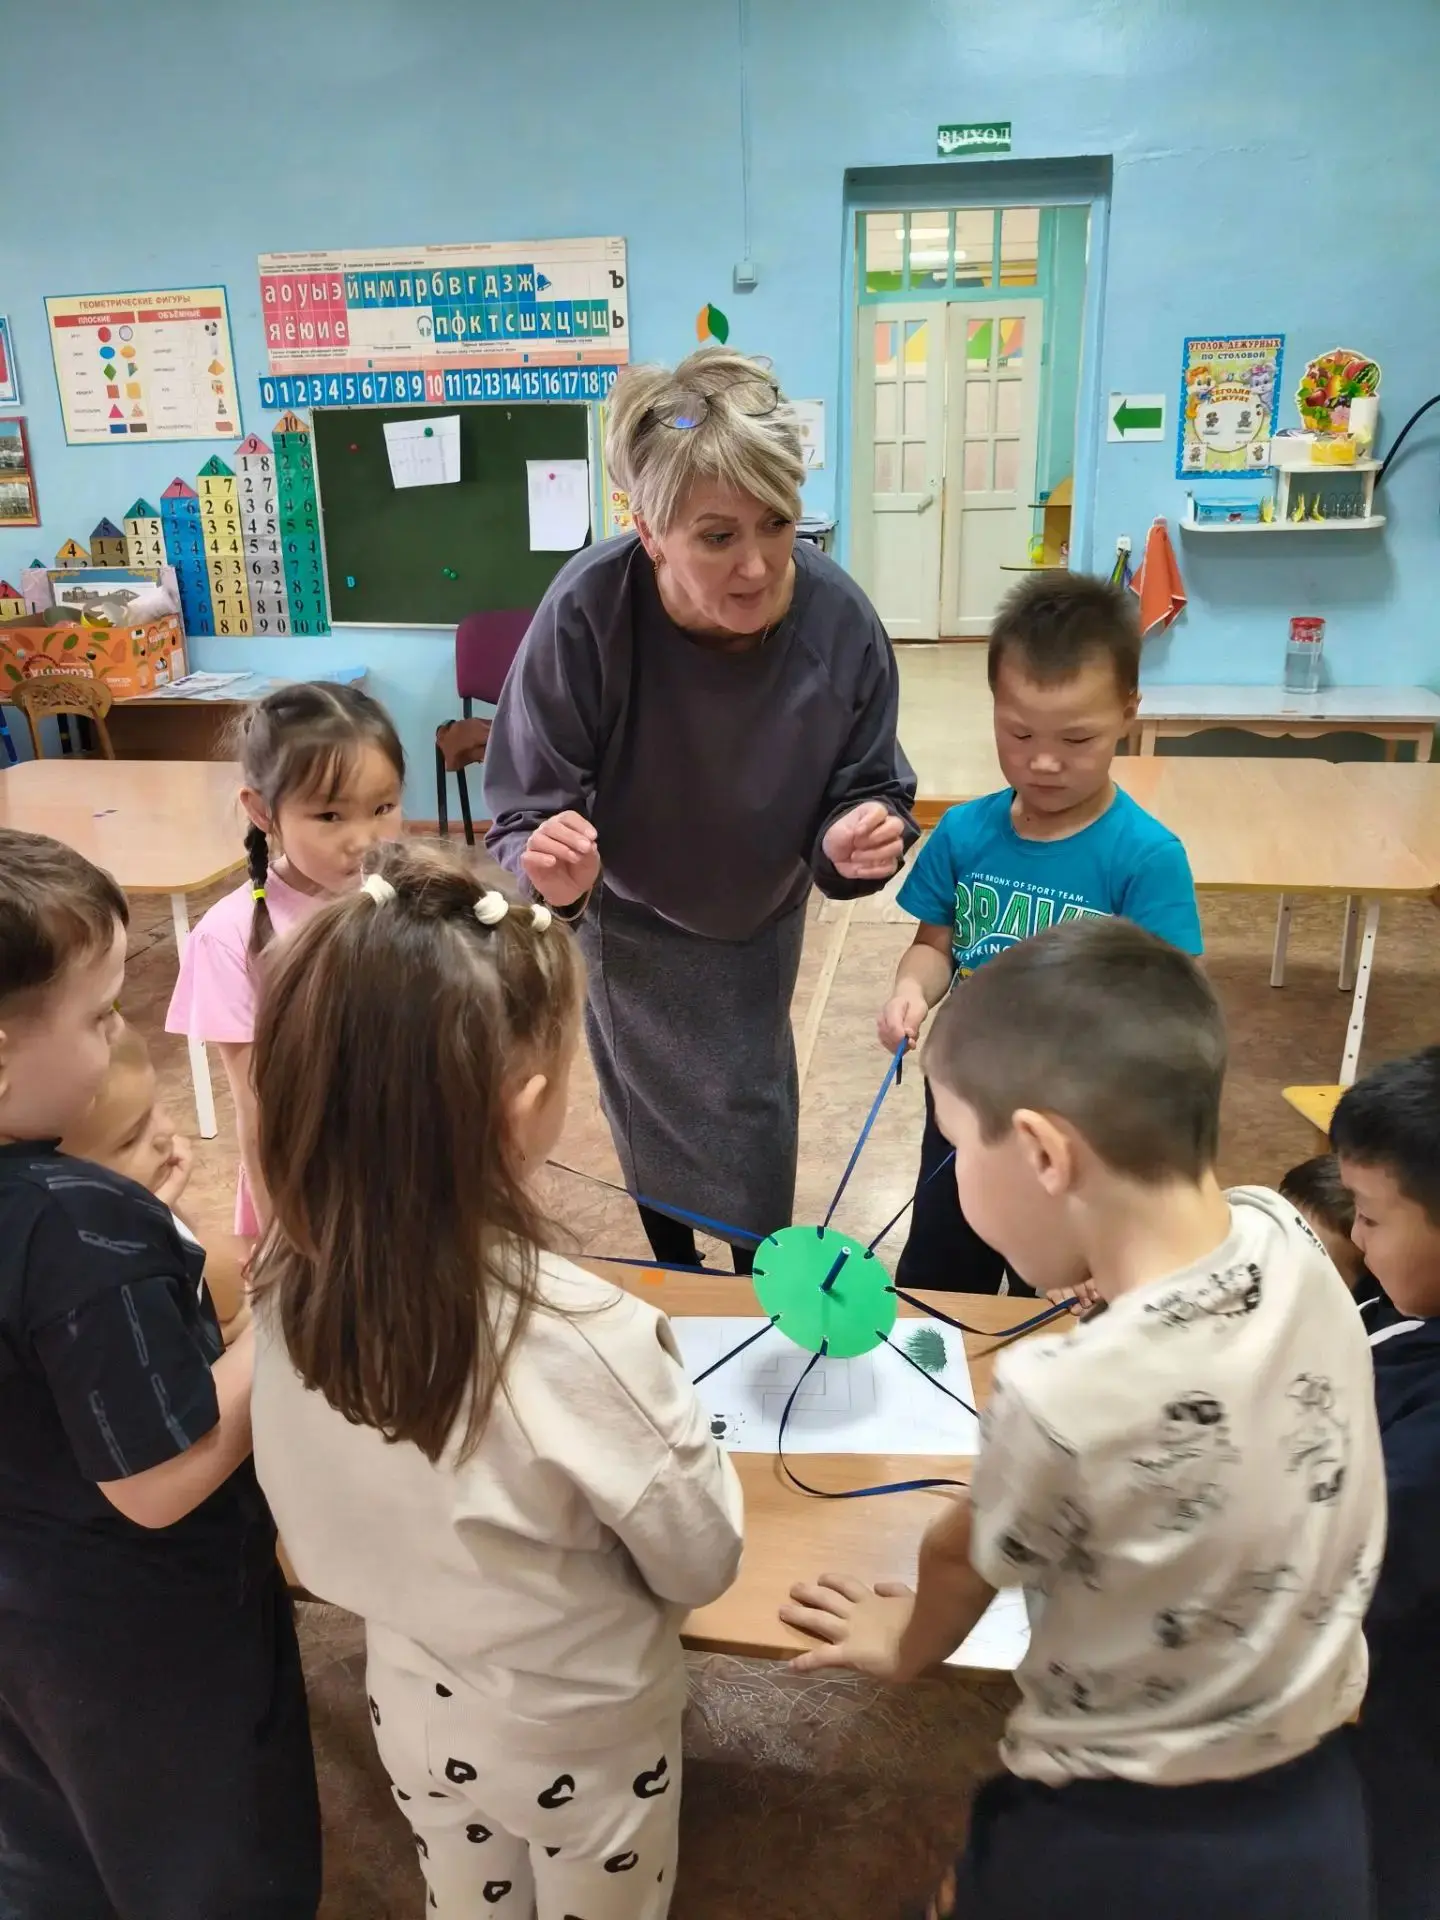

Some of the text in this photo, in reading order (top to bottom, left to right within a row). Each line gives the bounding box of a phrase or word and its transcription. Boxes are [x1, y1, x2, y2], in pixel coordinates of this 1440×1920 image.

[939, 127, 1010, 146] ВЫХОД
[79, 295, 191, 309] ГЕОМЕТРИЧЕСКИЕ ФИГУРЫ
[78, 315, 111, 325] ПЛОСКИЕ
[1190, 340, 1279, 350] УГОЛОК ДЕЖУРНЫХ
[1218, 351, 1265, 360] СТОЛОВОЙ
[264, 382, 274, 403] 0
[280, 382, 289, 403] 1
[296, 381, 306, 402] 2
[313, 380, 322, 401] 3
[328, 379, 339, 400] 4
[346, 378, 354, 399] 5
[362, 378, 372, 399] 6
[377, 377, 388, 398] 7
[395, 376, 406, 397] 8
[412, 376, 422, 397] 9
[428, 374, 442, 396] 10
[446, 374, 461, 396] 11
[465, 373, 481, 396] 12
[485, 373, 500, 395] 13
[504, 372, 521, 394] 14
[523, 372, 539, 394] 15
[543, 372, 559, 394] 16
[562, 372, 578, 394] 17
[581, 372, 598, 394] 18
[249, 439, 257, 453] 9
[210, 460, 218, 474] 8
[242, 456, 270, 470] 1 8
[205, 478, 233, 494] 1 7
[245, 478, 272, 492] 2 7
[137, 504, 145, 516] 6
[206, 500, 233, 514] 2 6
[246, 499, 274, 513] 3 6
[103, 523, 110, 535] 5
[133, 521, 159, 535] 1 5
[208, 521, 236, 535] 3 5
[248, 520, 276, 533] 4 5
[68, 544, 76, 557] 4
[100, 540, 124, 554] 1 4
[136, 541, 161, 555] 2 4
[210, 540, 238, 554] 4 4
[250, 539, 278, 554] 5 4
[214, 561, 241, 575] 5 3
[253, 560, 280, 575] 6 3
[216, 580, 243, 595] 6 2
[256, 580, 282, 594] 7 2
[218, 600, 244, 614] 7 1
[257, 600, 283, 614] 8 1
[221, 620, 248, 634] 8 0
[260, 619, 286, 633] 9 0
[971, 872, 1084, 903] THE BRONX OF SPORT TEAM
[952, 881, 1114, 948] BRAV
